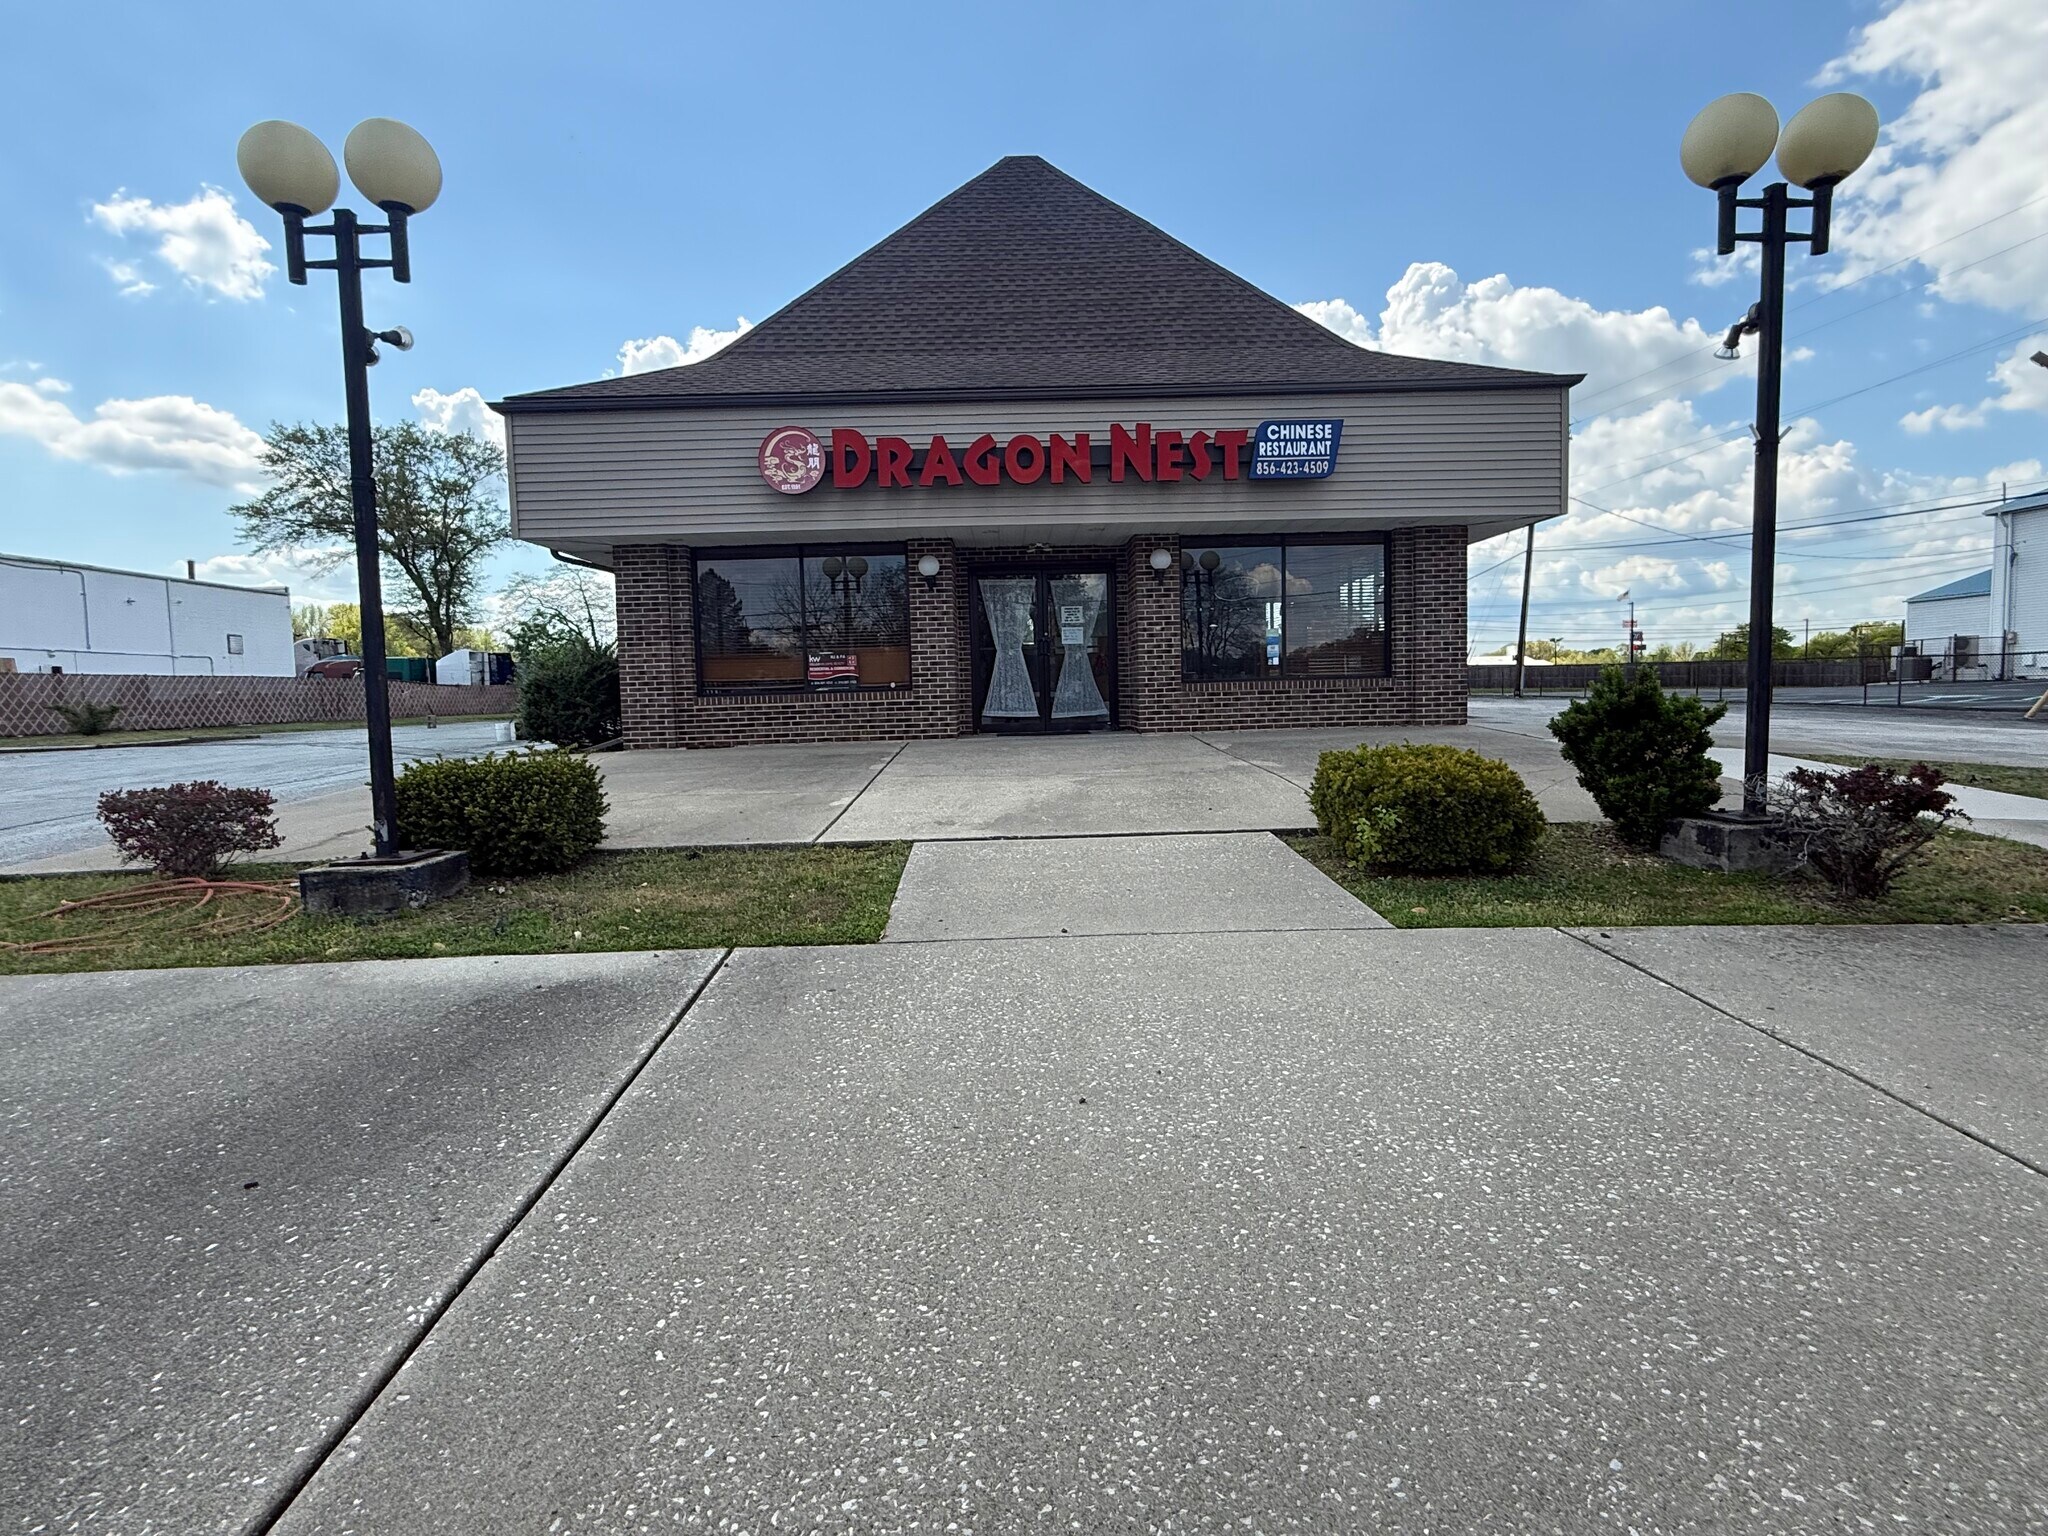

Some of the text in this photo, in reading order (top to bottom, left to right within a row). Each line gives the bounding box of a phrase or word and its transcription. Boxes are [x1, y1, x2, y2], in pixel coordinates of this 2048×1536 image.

[1266, 423, 1332, 440] CHINESE
[831, 422, 1249, 488] DRAGON NEST
[1259, 440, 1332, 456] RESTAURANT
[1256, 460, 1329, 475] 856-423-4509
